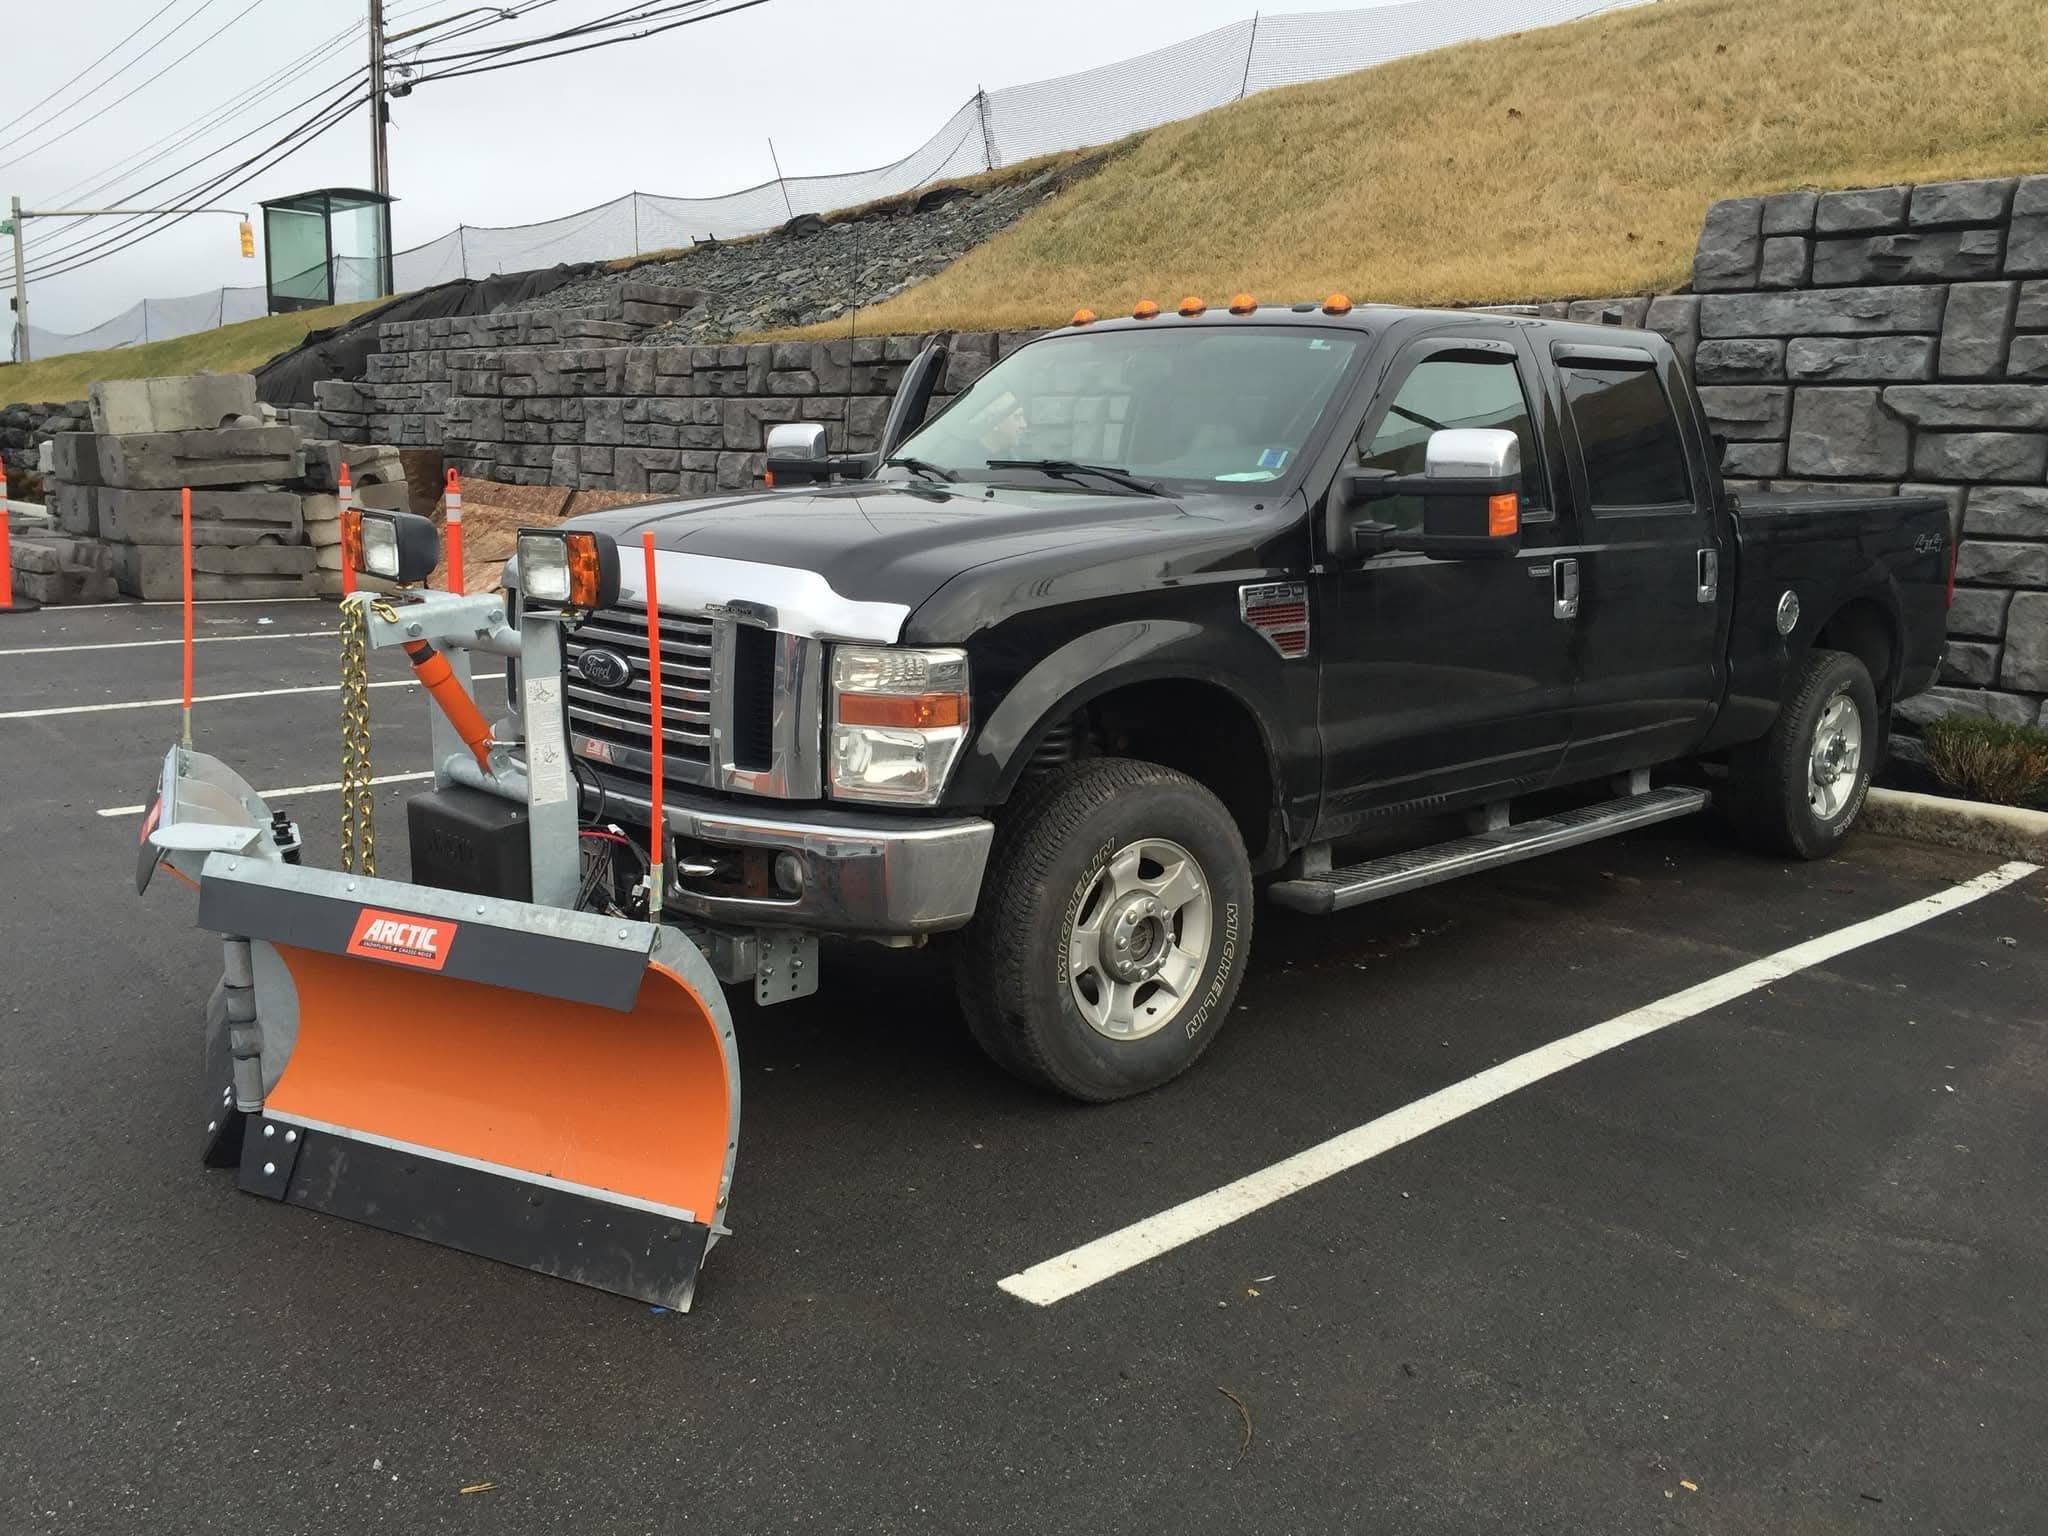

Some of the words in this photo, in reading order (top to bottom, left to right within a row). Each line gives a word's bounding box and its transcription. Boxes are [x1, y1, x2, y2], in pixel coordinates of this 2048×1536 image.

[585, 655, 612, 679] Ford
[362, 918, 438, 952] ARCTIC
[1057, 836, 1115, 984] MICHELIN
[1185, 903, 1239, 1040] MICHELIN
